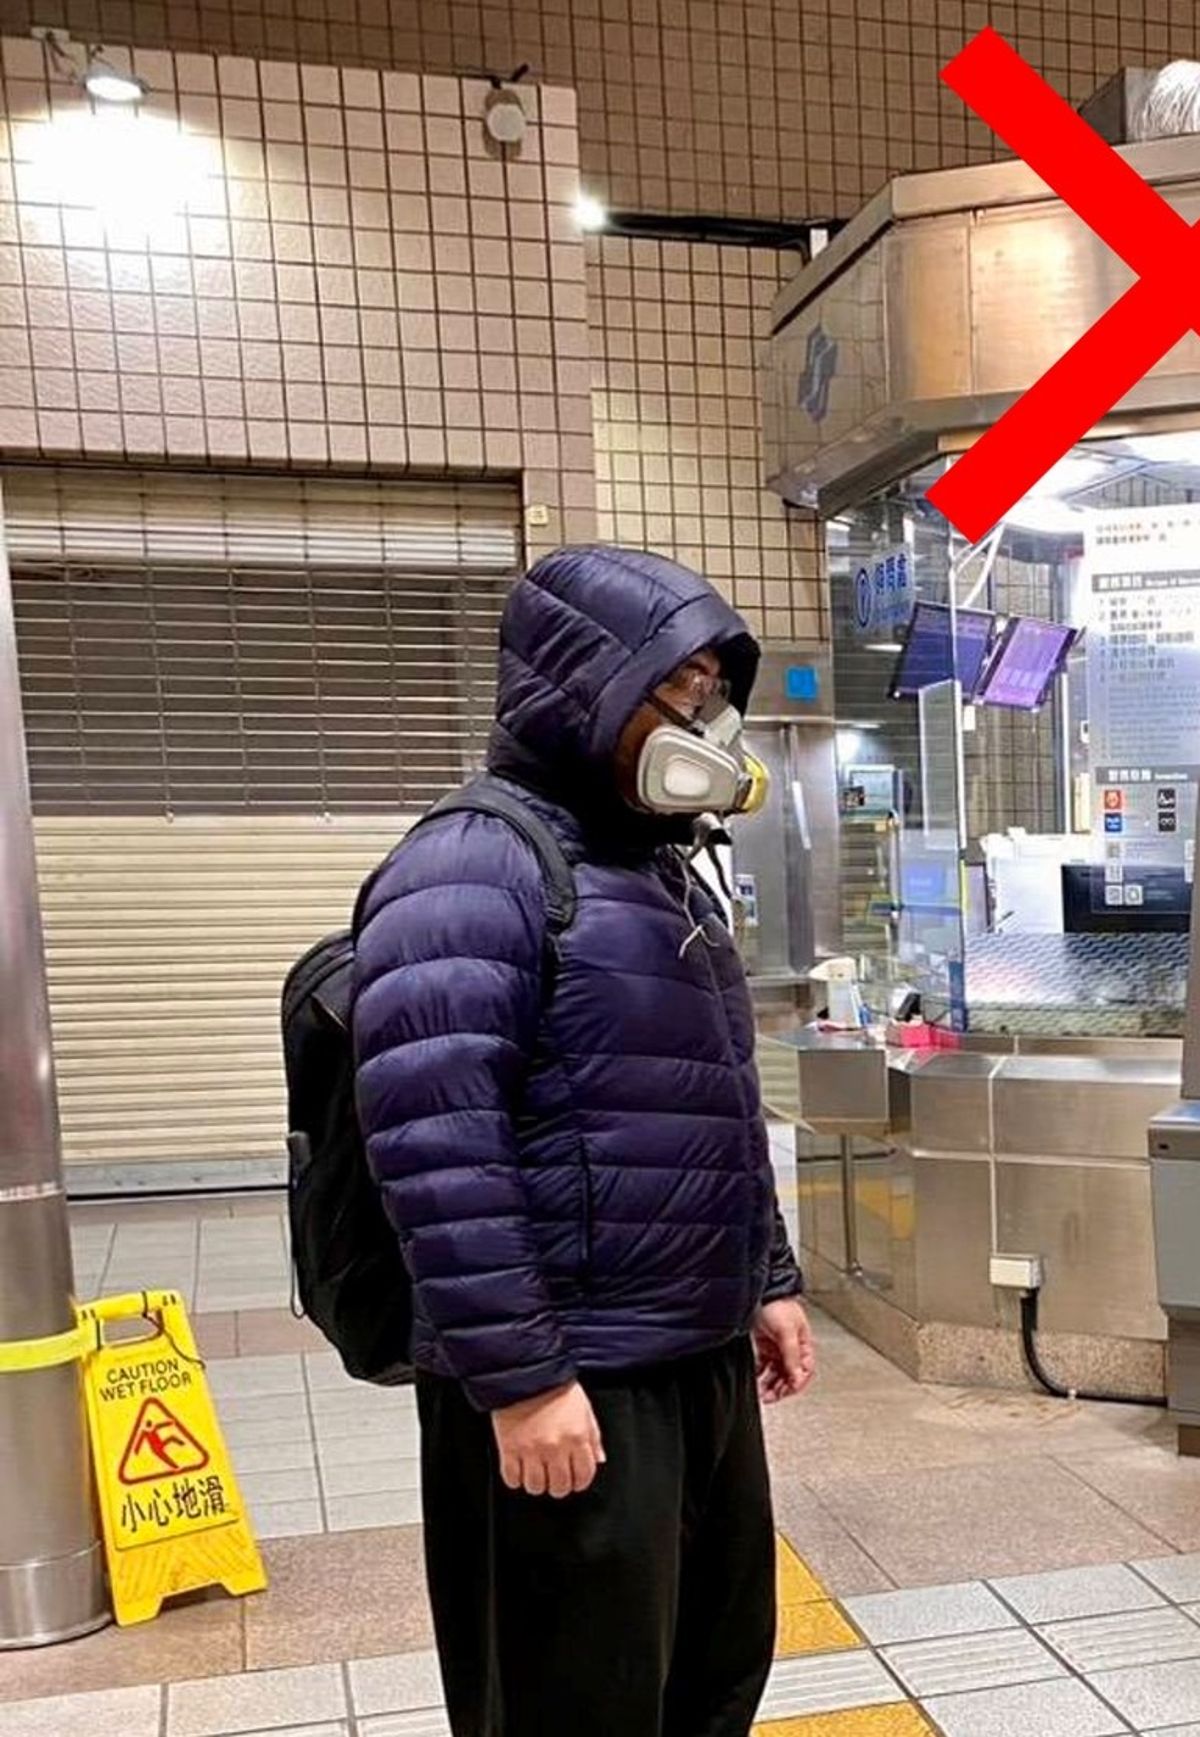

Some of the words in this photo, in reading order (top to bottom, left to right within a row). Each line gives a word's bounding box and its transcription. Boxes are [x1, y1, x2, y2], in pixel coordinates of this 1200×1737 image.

[99, 1382, 135, 1402] WET
[139, 1371, 192, 1395] FLOOR
[106, 1358, 179, 1385] CAUTION
[120, 1475, 227, 1533] 小心地滑
